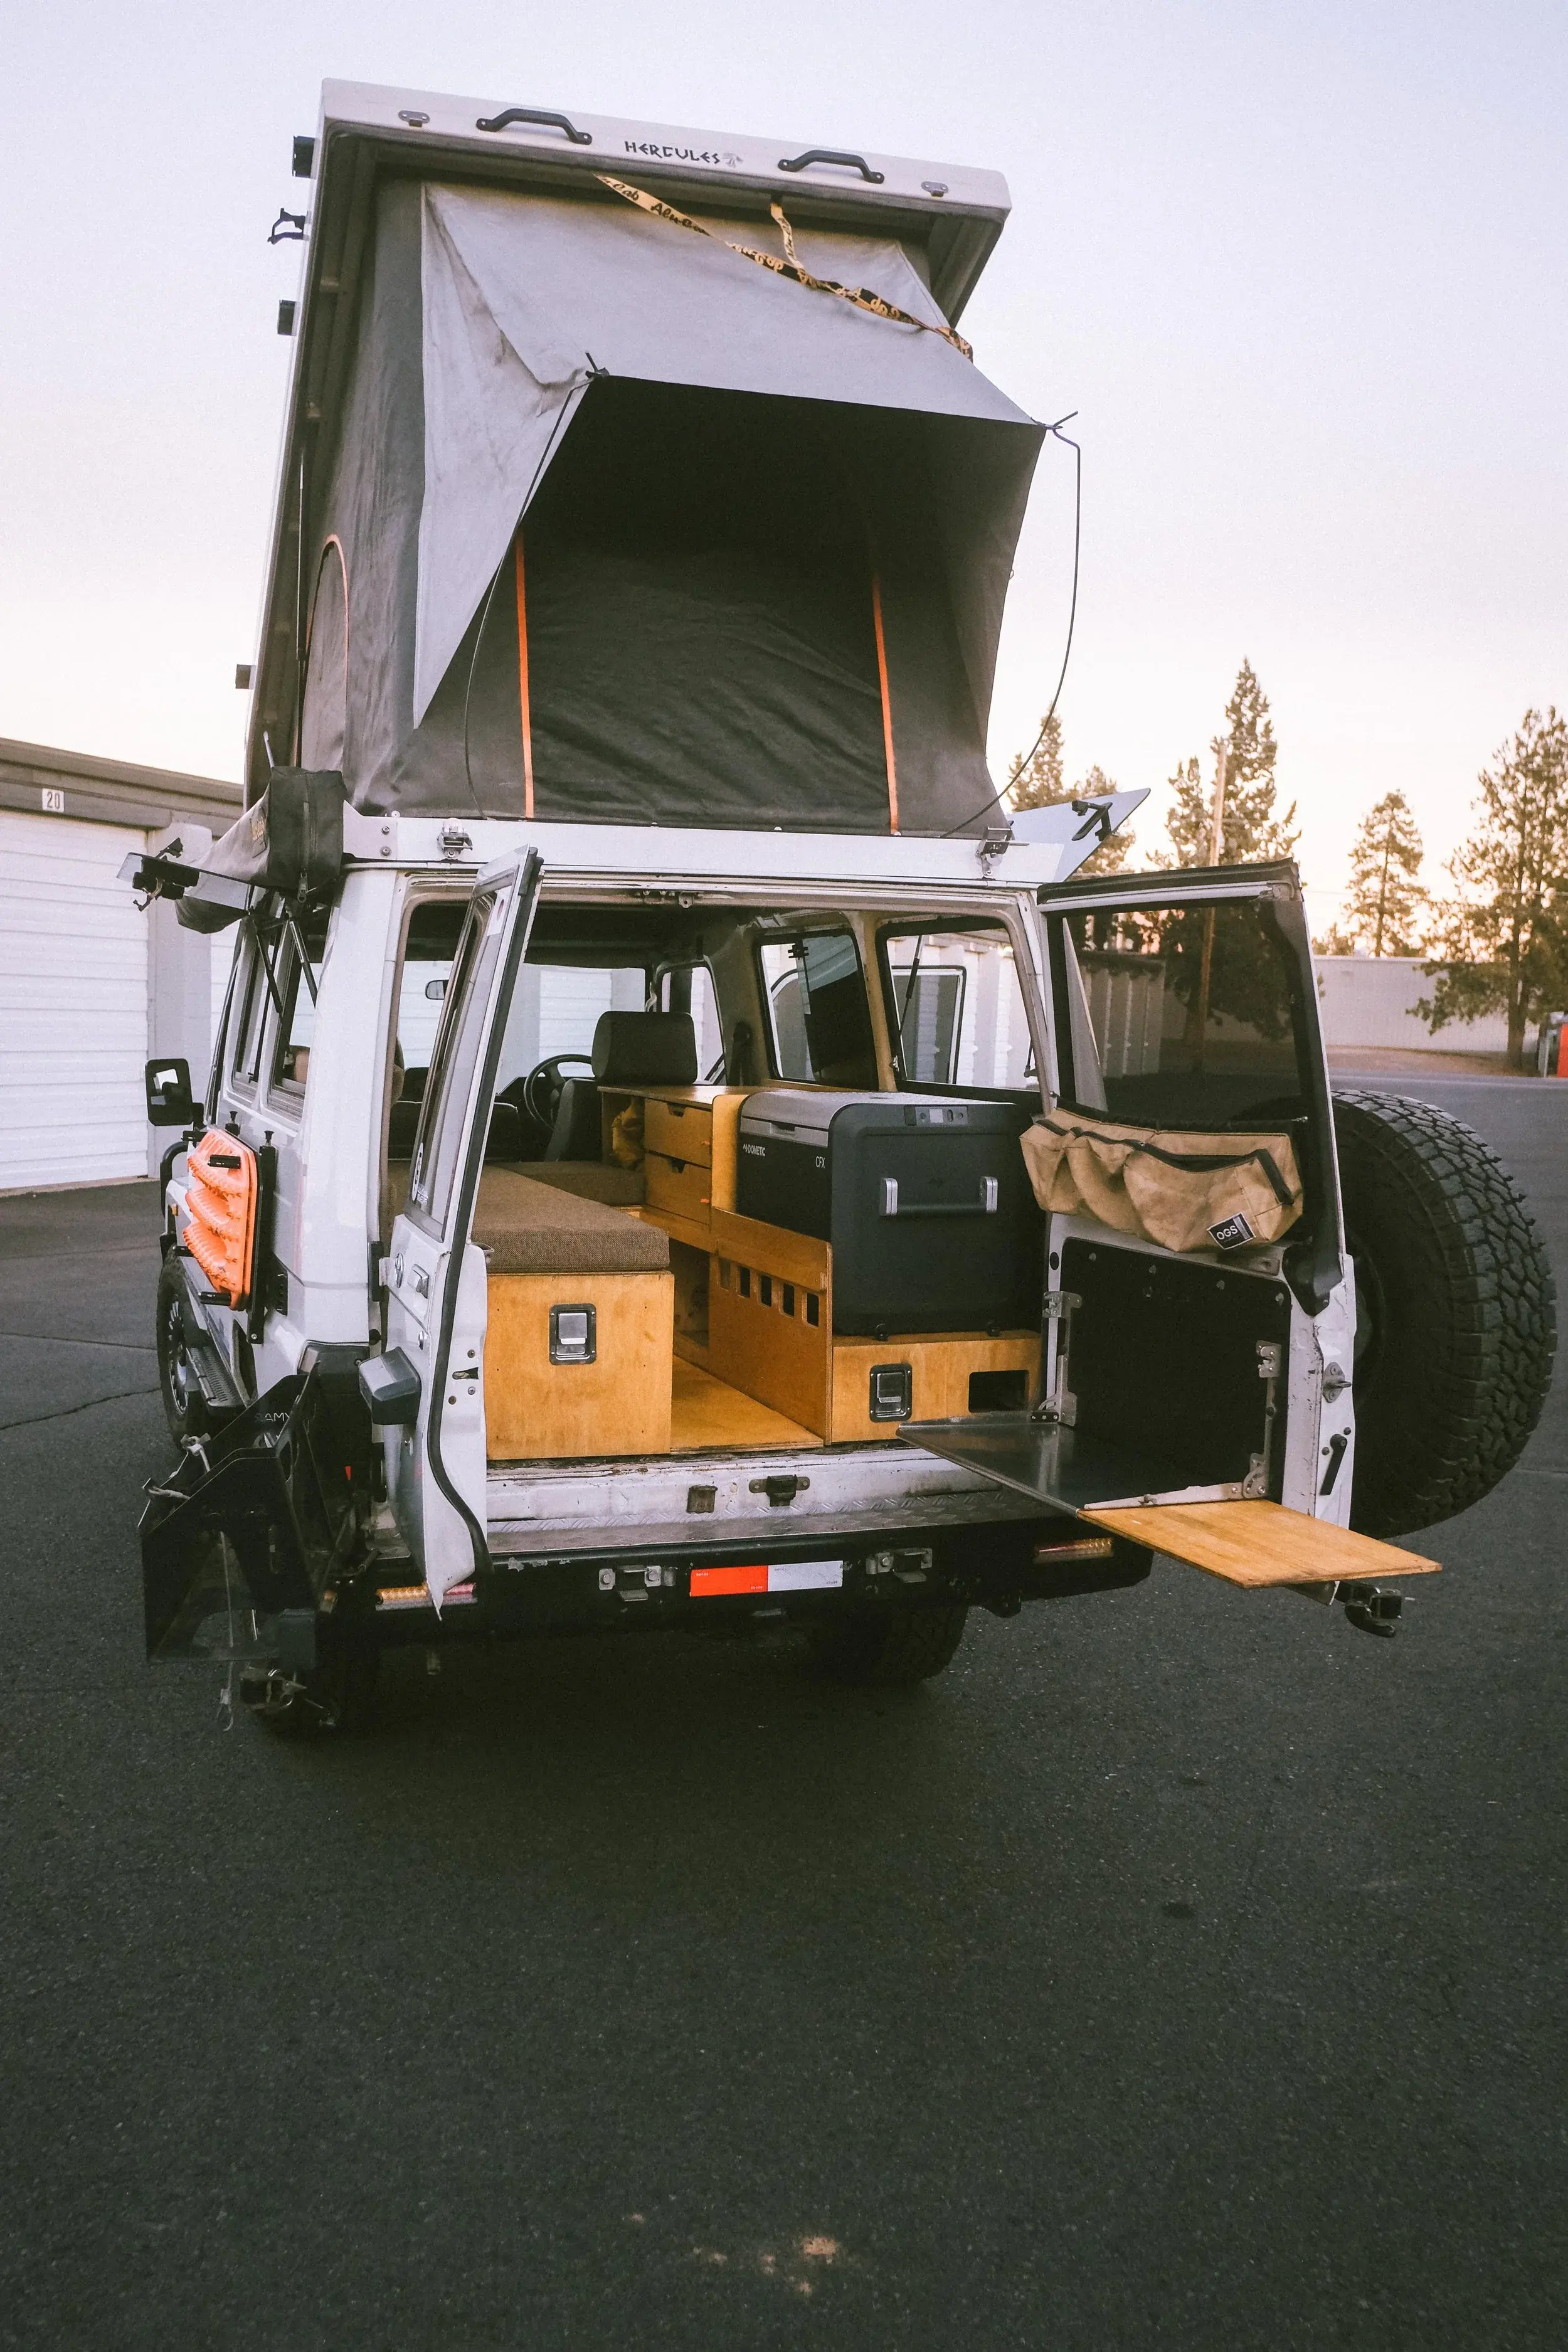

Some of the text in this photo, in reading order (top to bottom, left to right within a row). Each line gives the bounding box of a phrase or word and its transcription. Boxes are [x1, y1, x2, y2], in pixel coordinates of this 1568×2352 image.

[625, 141, 721, 164] HERCULES
[47, 792, 60, 809] 20
[748, 1144, 765, 1157] DOMETIC
[815, 1156, 825, 1168] CFX
[1217, 1225, 1238, 1240] OGS
